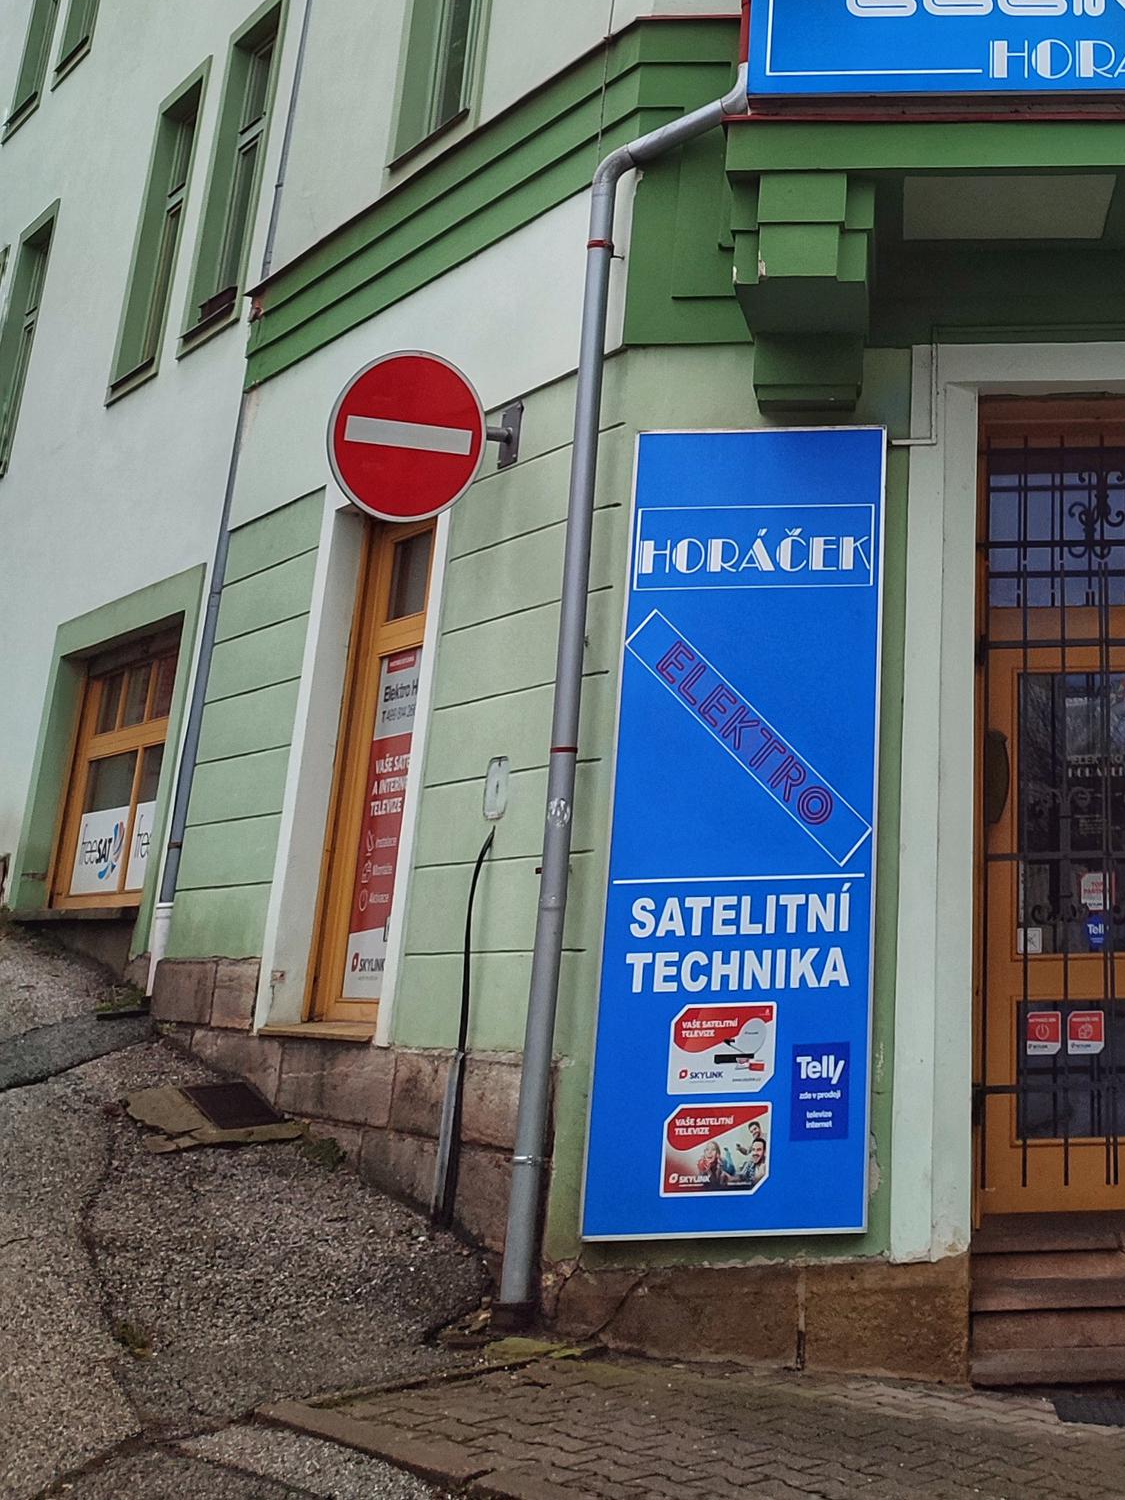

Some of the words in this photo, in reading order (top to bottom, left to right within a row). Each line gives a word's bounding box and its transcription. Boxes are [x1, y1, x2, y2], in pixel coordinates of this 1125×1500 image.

[637, 527, 870, 575] HORÁČEK
[656, 640, 834, 825] ELEKTRO
[375, 753, 394, 775] VAŠE
[371, 780, 378, 796] A
[370, 797, 403, 817] TELEVIZE
[78, 823, 113, 866] freeSAT
[629, 883, 852, 938] SATELITNÍ
[1086, 923, 1110, 935] Tell
[625, 947, 849, 993] TECHNIKA
[681, 1019, 701, 1029] VAŠE
[702, 1017, 739, 1028] SATELITNÍ
[681, 1029, 715, 1038] TELEVIZE
[689, 1070, 724, 1079] SKYLINK
[796, 1054, 845, 1084] Telly
[674, 1116, 695, 1127] VAŠE
[696, 1115, 734, 1126] SATELITNÍ
[674, 1127, 710, 1136] TELEVIZE
